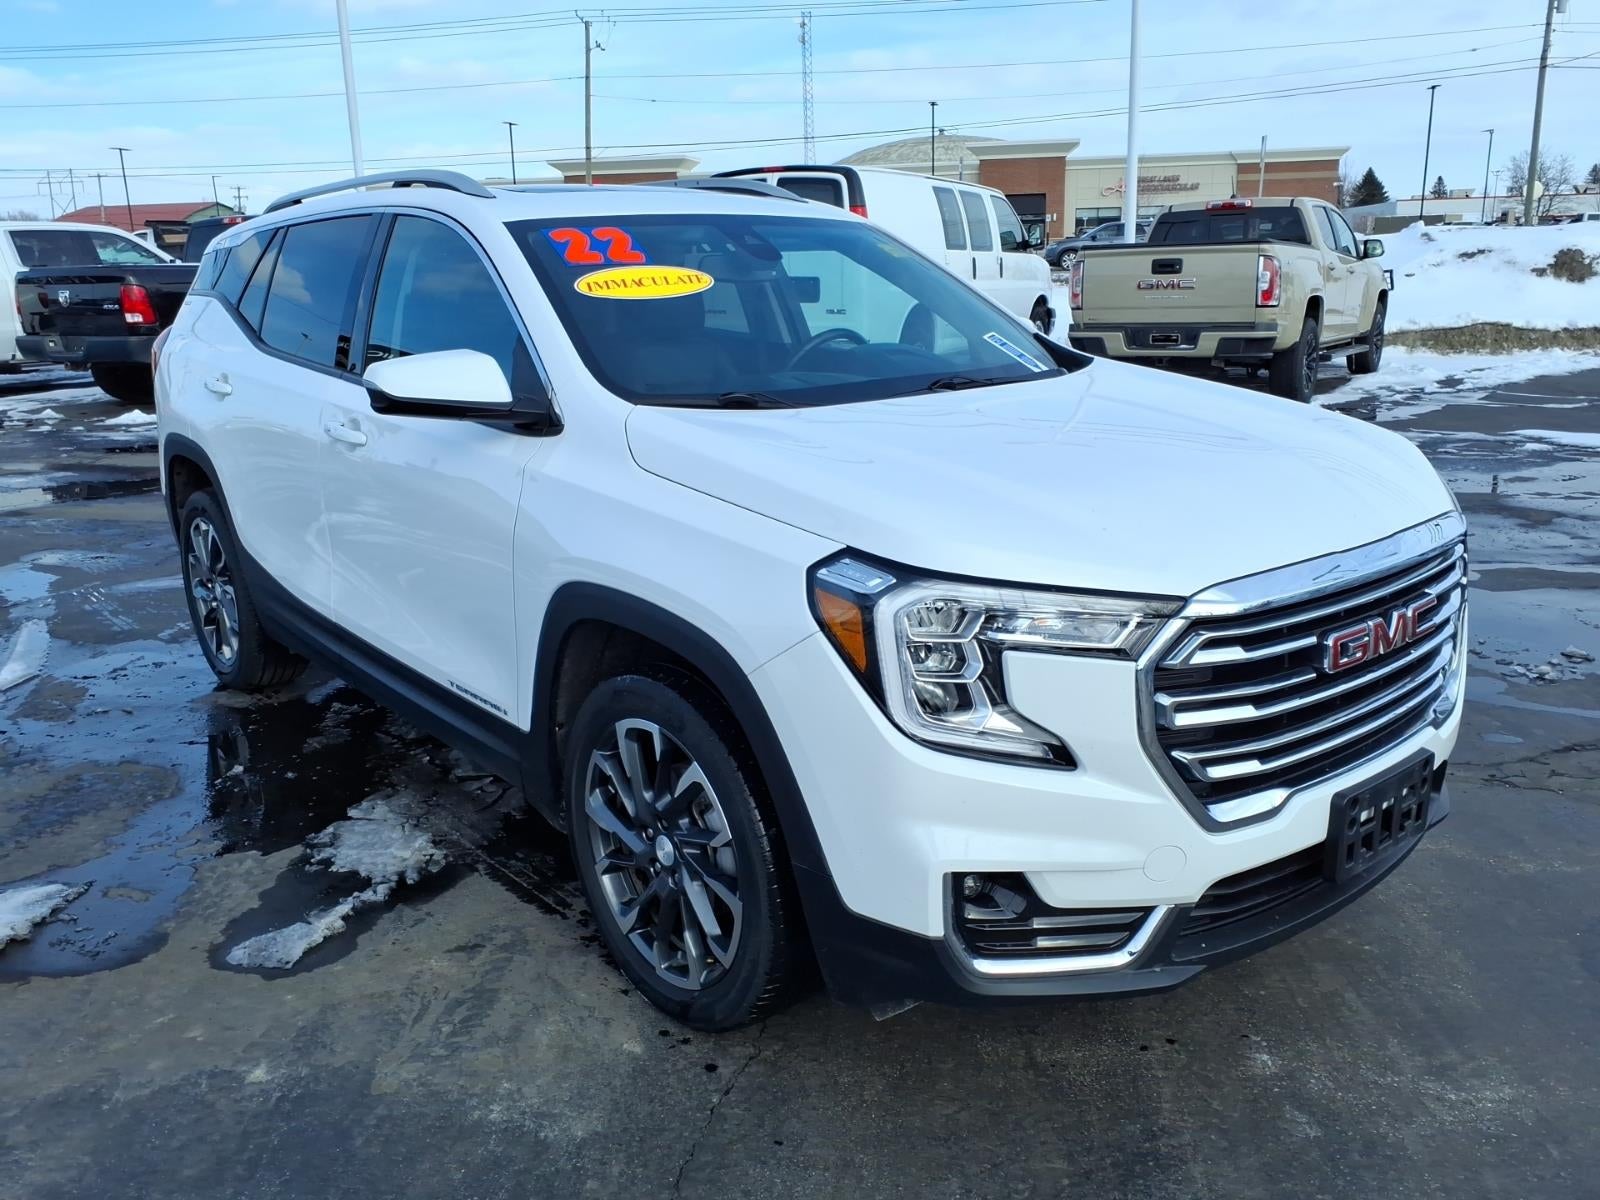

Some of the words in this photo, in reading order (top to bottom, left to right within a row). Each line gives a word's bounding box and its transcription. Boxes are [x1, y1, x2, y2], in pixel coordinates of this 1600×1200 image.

[549, 226, 646, 264] 22
[586, 273, 708, 292] IMMACULATE
[1137, 278, 1196, 290] GMC
[1324, 594, 1438, 674] GMC
